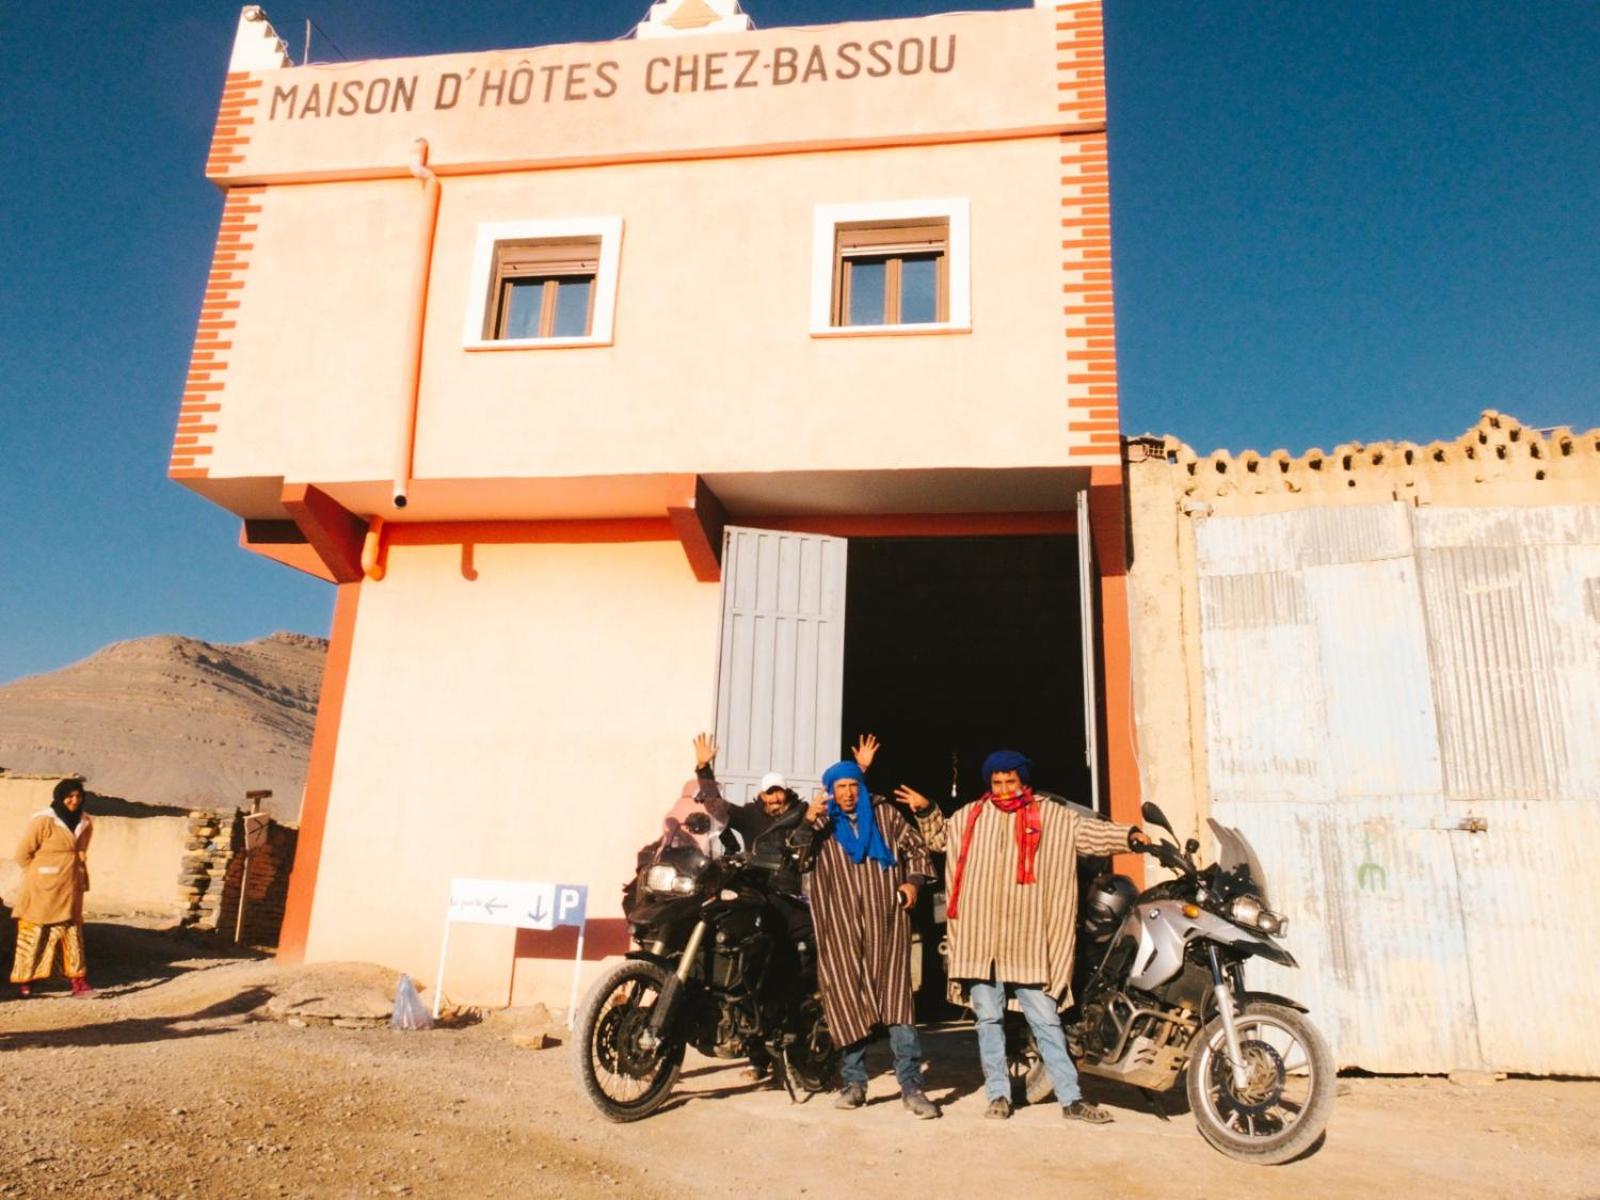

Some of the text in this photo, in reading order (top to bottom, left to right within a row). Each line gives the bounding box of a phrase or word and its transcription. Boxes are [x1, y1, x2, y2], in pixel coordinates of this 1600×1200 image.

[269, 76, 418, 120] MAISON
[434, 59, 619, 110] D'HÔTES
[558, 888, 580, 921] P
